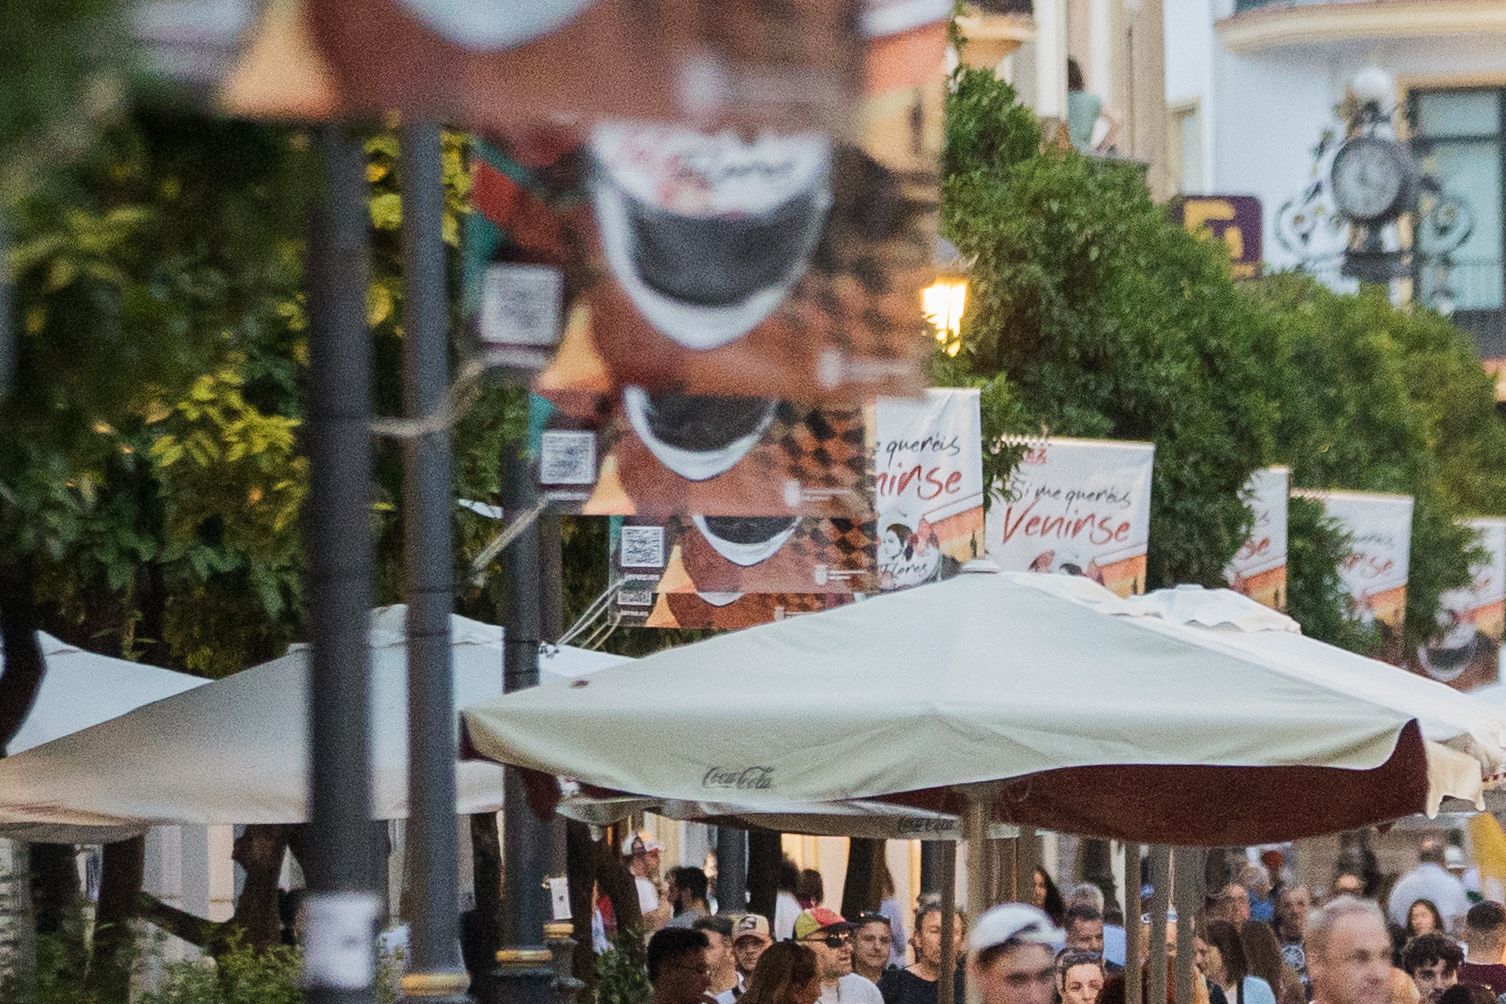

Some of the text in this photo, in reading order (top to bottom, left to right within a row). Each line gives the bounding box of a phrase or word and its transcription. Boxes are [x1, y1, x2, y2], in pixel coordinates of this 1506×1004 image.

[886, 433, 961, 468] queréis
[875, 463, 962, 500] nirse
[1002, 500, 1131, 545] Venirse
